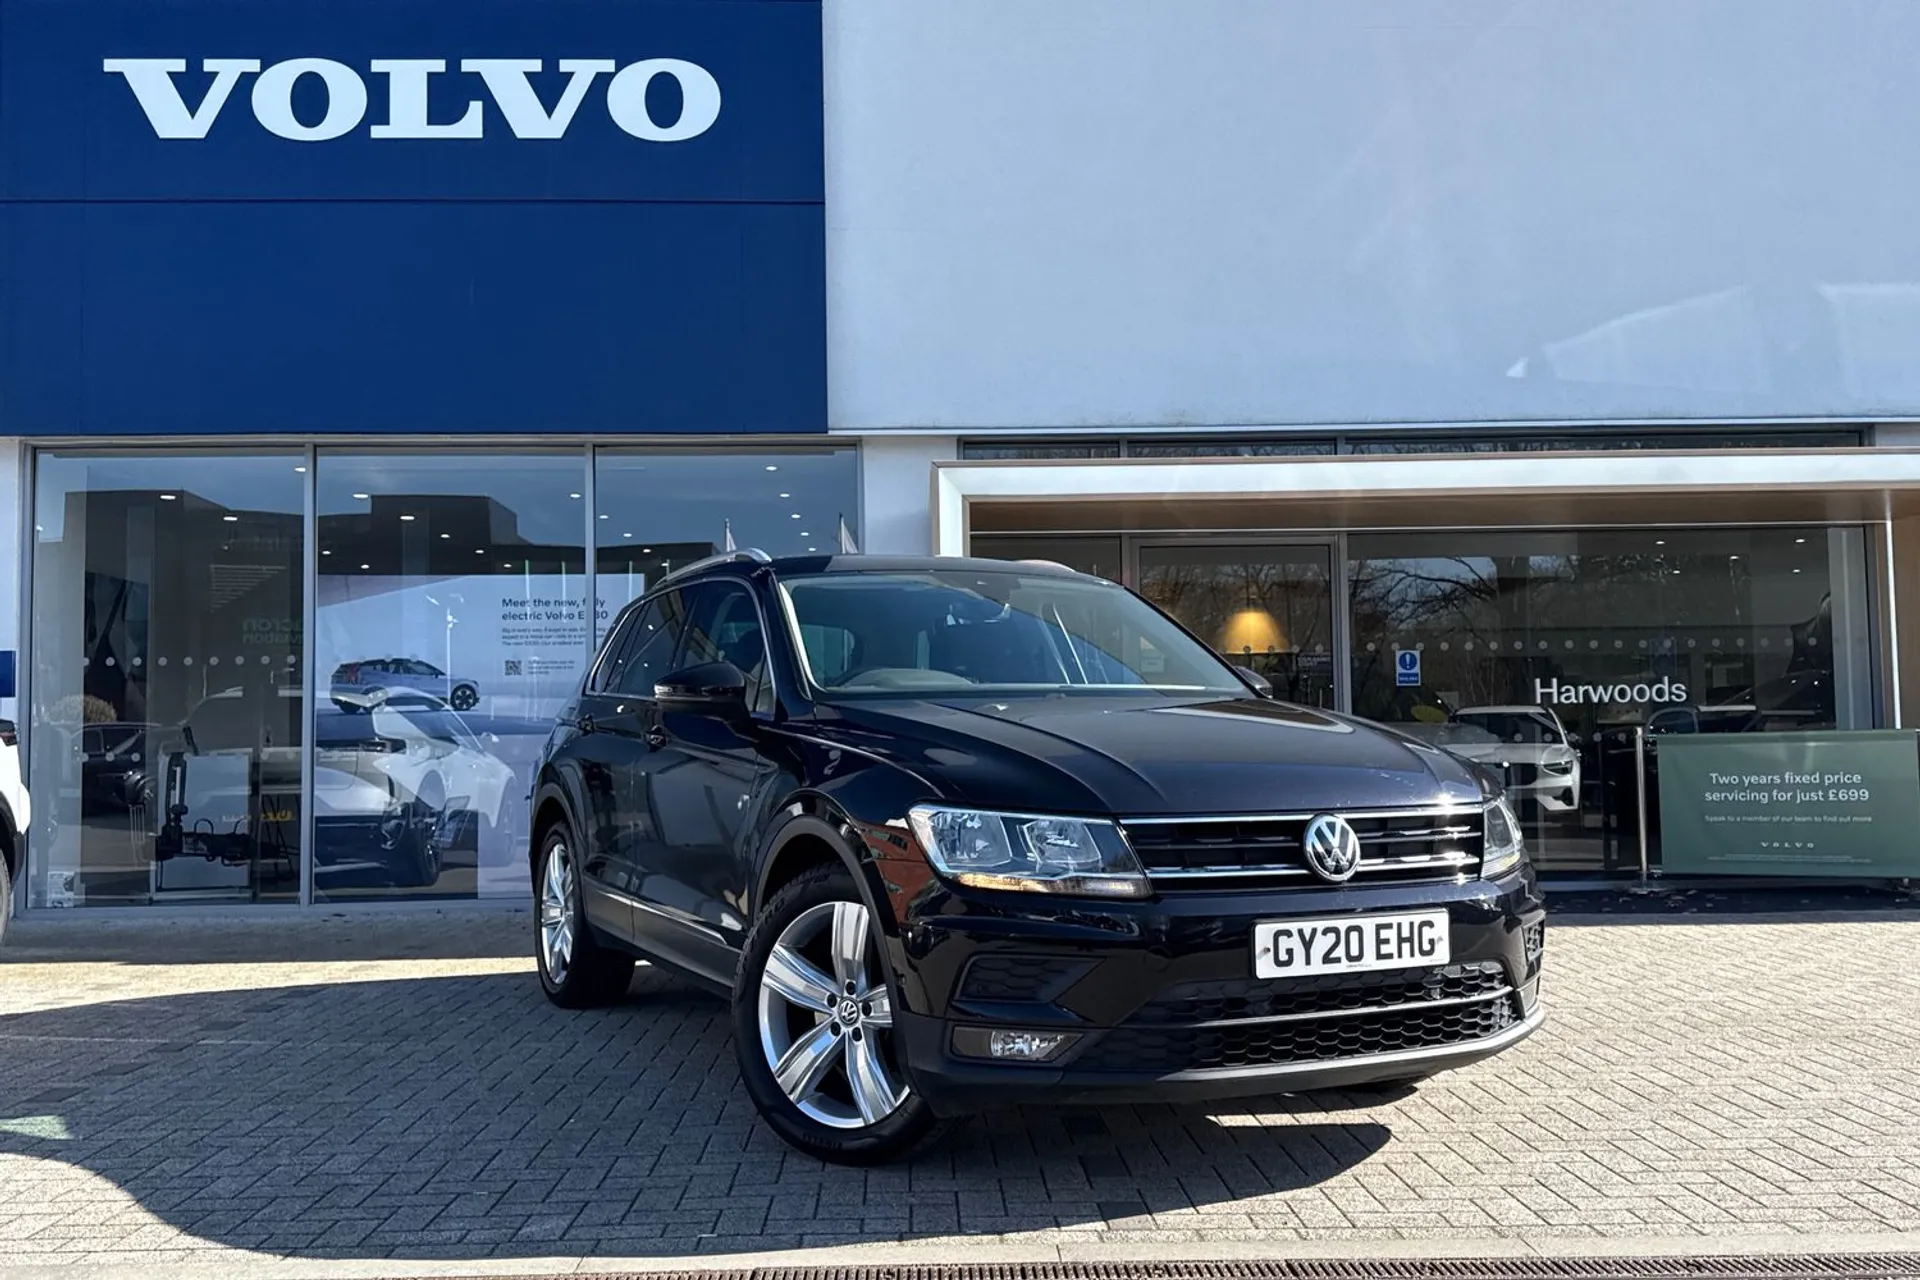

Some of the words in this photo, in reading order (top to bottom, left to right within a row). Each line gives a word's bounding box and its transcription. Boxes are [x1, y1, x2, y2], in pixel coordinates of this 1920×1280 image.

[103, 57, 722, 141] VOLVO
[501, 598, 530, 608] Meet
[532, 598, 551, 607] the
[501, 610, 543, 620] electric
[545, 610, 575, 620] Volvo
[578, 610, 608, 620] E30
[1534, 675, 1688, 704] Harwoods
[1709, 772, 1740, 785] Two
[1742, 773, 1782, 788] years
[1784, 771, 1820, 785] fixed
[1824, 771, 1863, 786] price
[1704, 789, 1769, 804] servicing
[1772, 789, 1793, 802] for
[1796, 789, 1825, 804] just
[1828, 788, 1870, 802] £699
[1761, 841, 1815, 849] VOLVO
[1272, 925, 1365, 968] GY20
[1375, 920, 1435, 961] EHG
